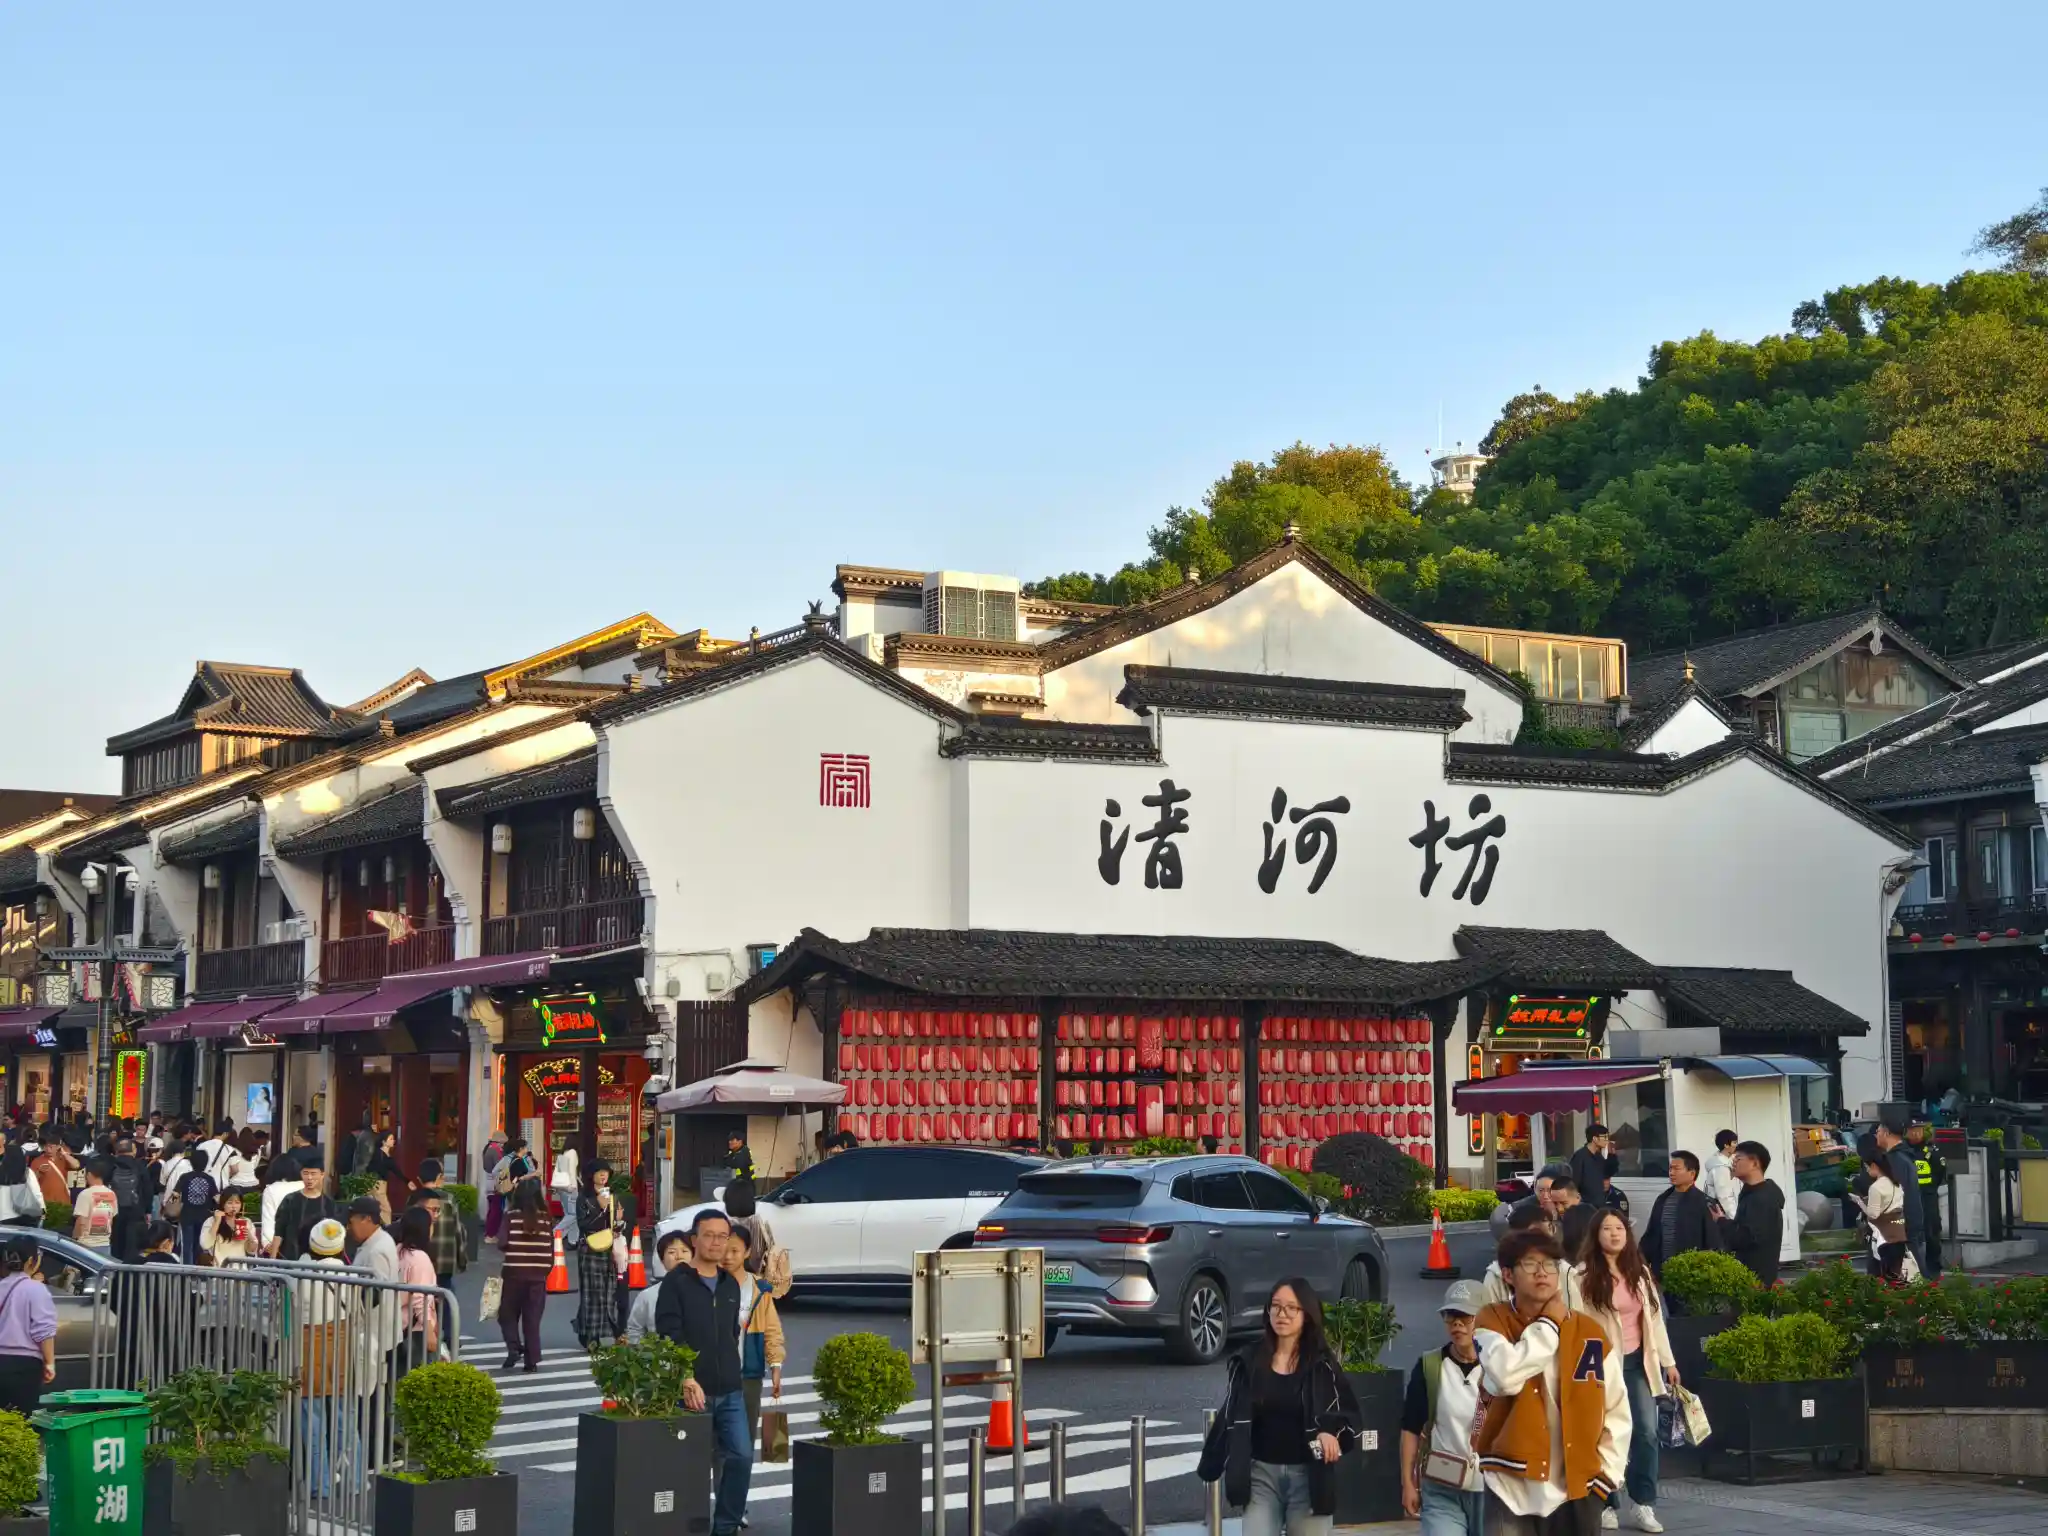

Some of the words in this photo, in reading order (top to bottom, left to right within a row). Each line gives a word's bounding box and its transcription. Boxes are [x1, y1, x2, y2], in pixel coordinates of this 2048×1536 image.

[1098, 778, 1506, 907] 清河坊
[1572, 1337, 1605, 1383] A
[92, 1436, 129, 1525] 印湖
